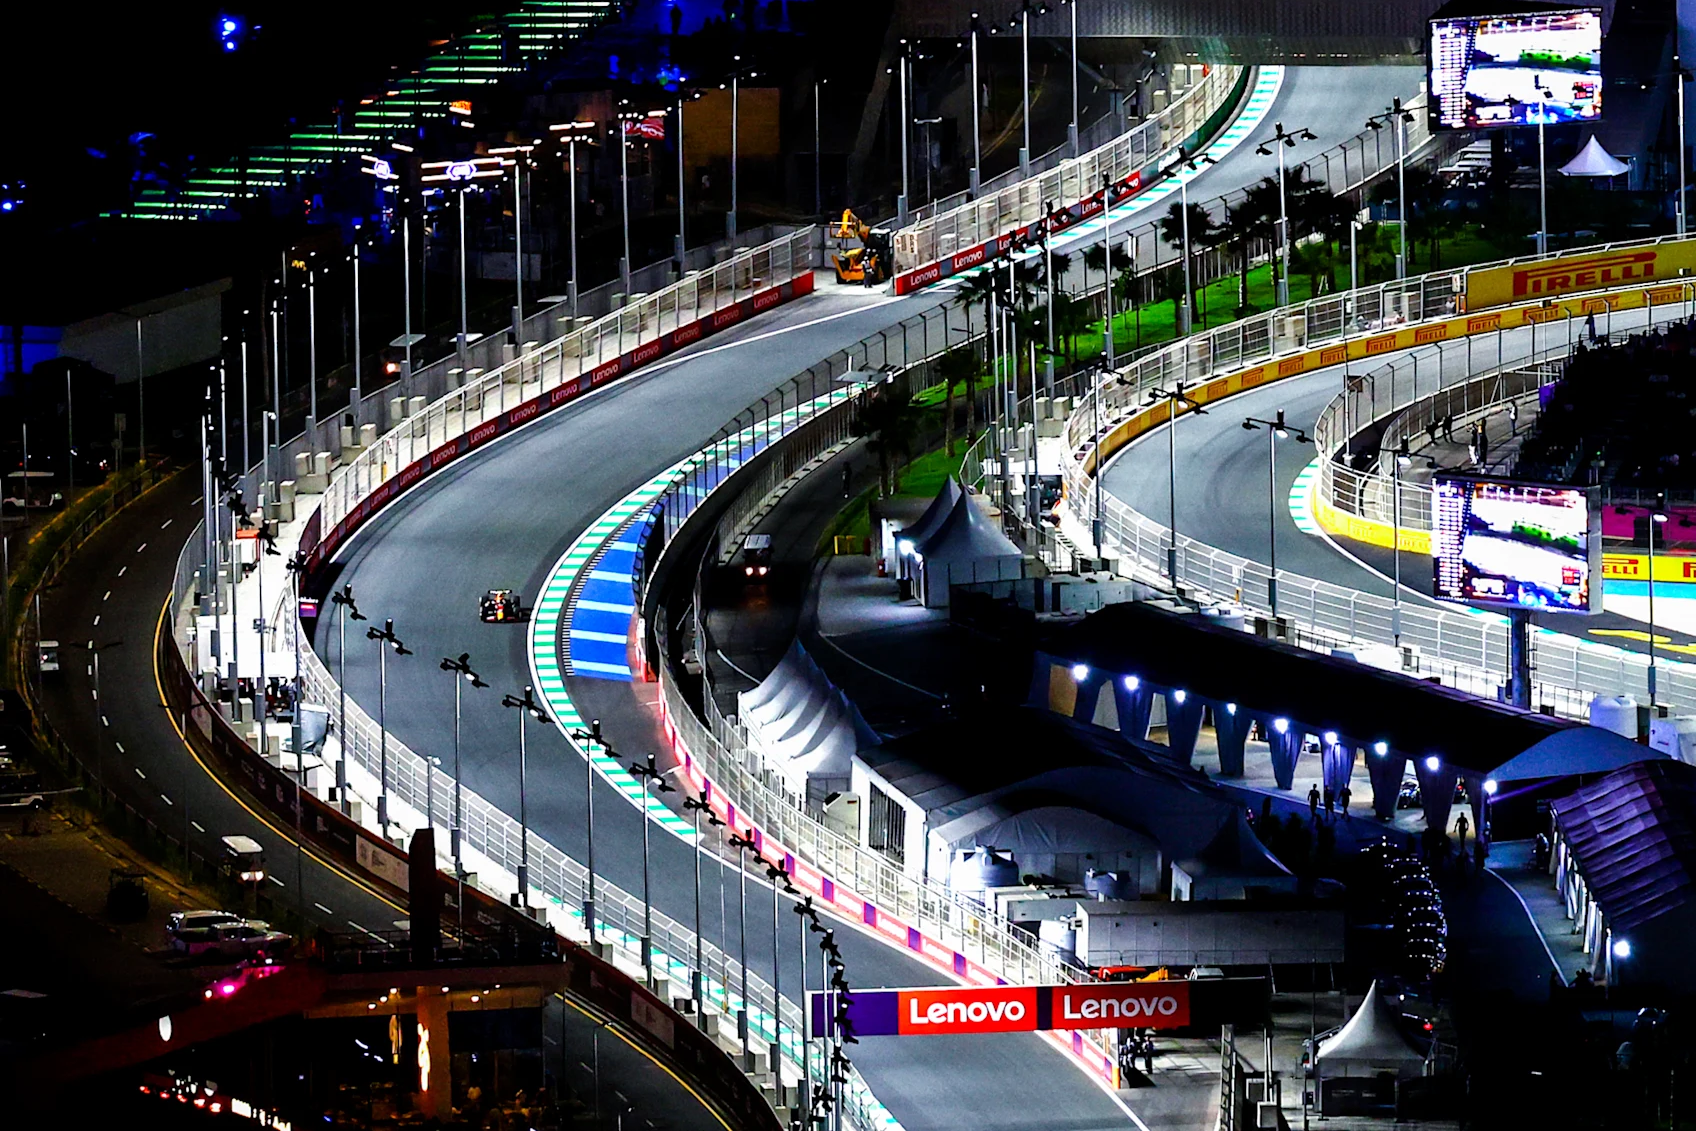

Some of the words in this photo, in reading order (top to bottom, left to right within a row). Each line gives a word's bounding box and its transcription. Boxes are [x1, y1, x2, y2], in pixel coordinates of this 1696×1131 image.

[954, 249, 983, 268] Lenovo
[911, 267, 938, 287] Lenovo
[1513, 251, 1657, 297] PIRELLI
[1467, 313, 1501, 332] PIRELLI
[1366, 334, 1396, 354] PIRELLI
[1415, 324, 1447, 344] PIRELLI
[633, 344, 659, 364] Lenovo
[592, 364, 619, 383] Lenovo
[550, 383, 578, 403] Lenovo
[510, 402, 537, 424] Lenovo
[470, 423, 496, 444] Lenovo
[432, 444, 456, 466] Lenovo
[1602, 557, 1639, 575] ELLI
[909, 997, 1026, 1025] Lenovo
[1063, 994, 1178, 1021] Lenovo
